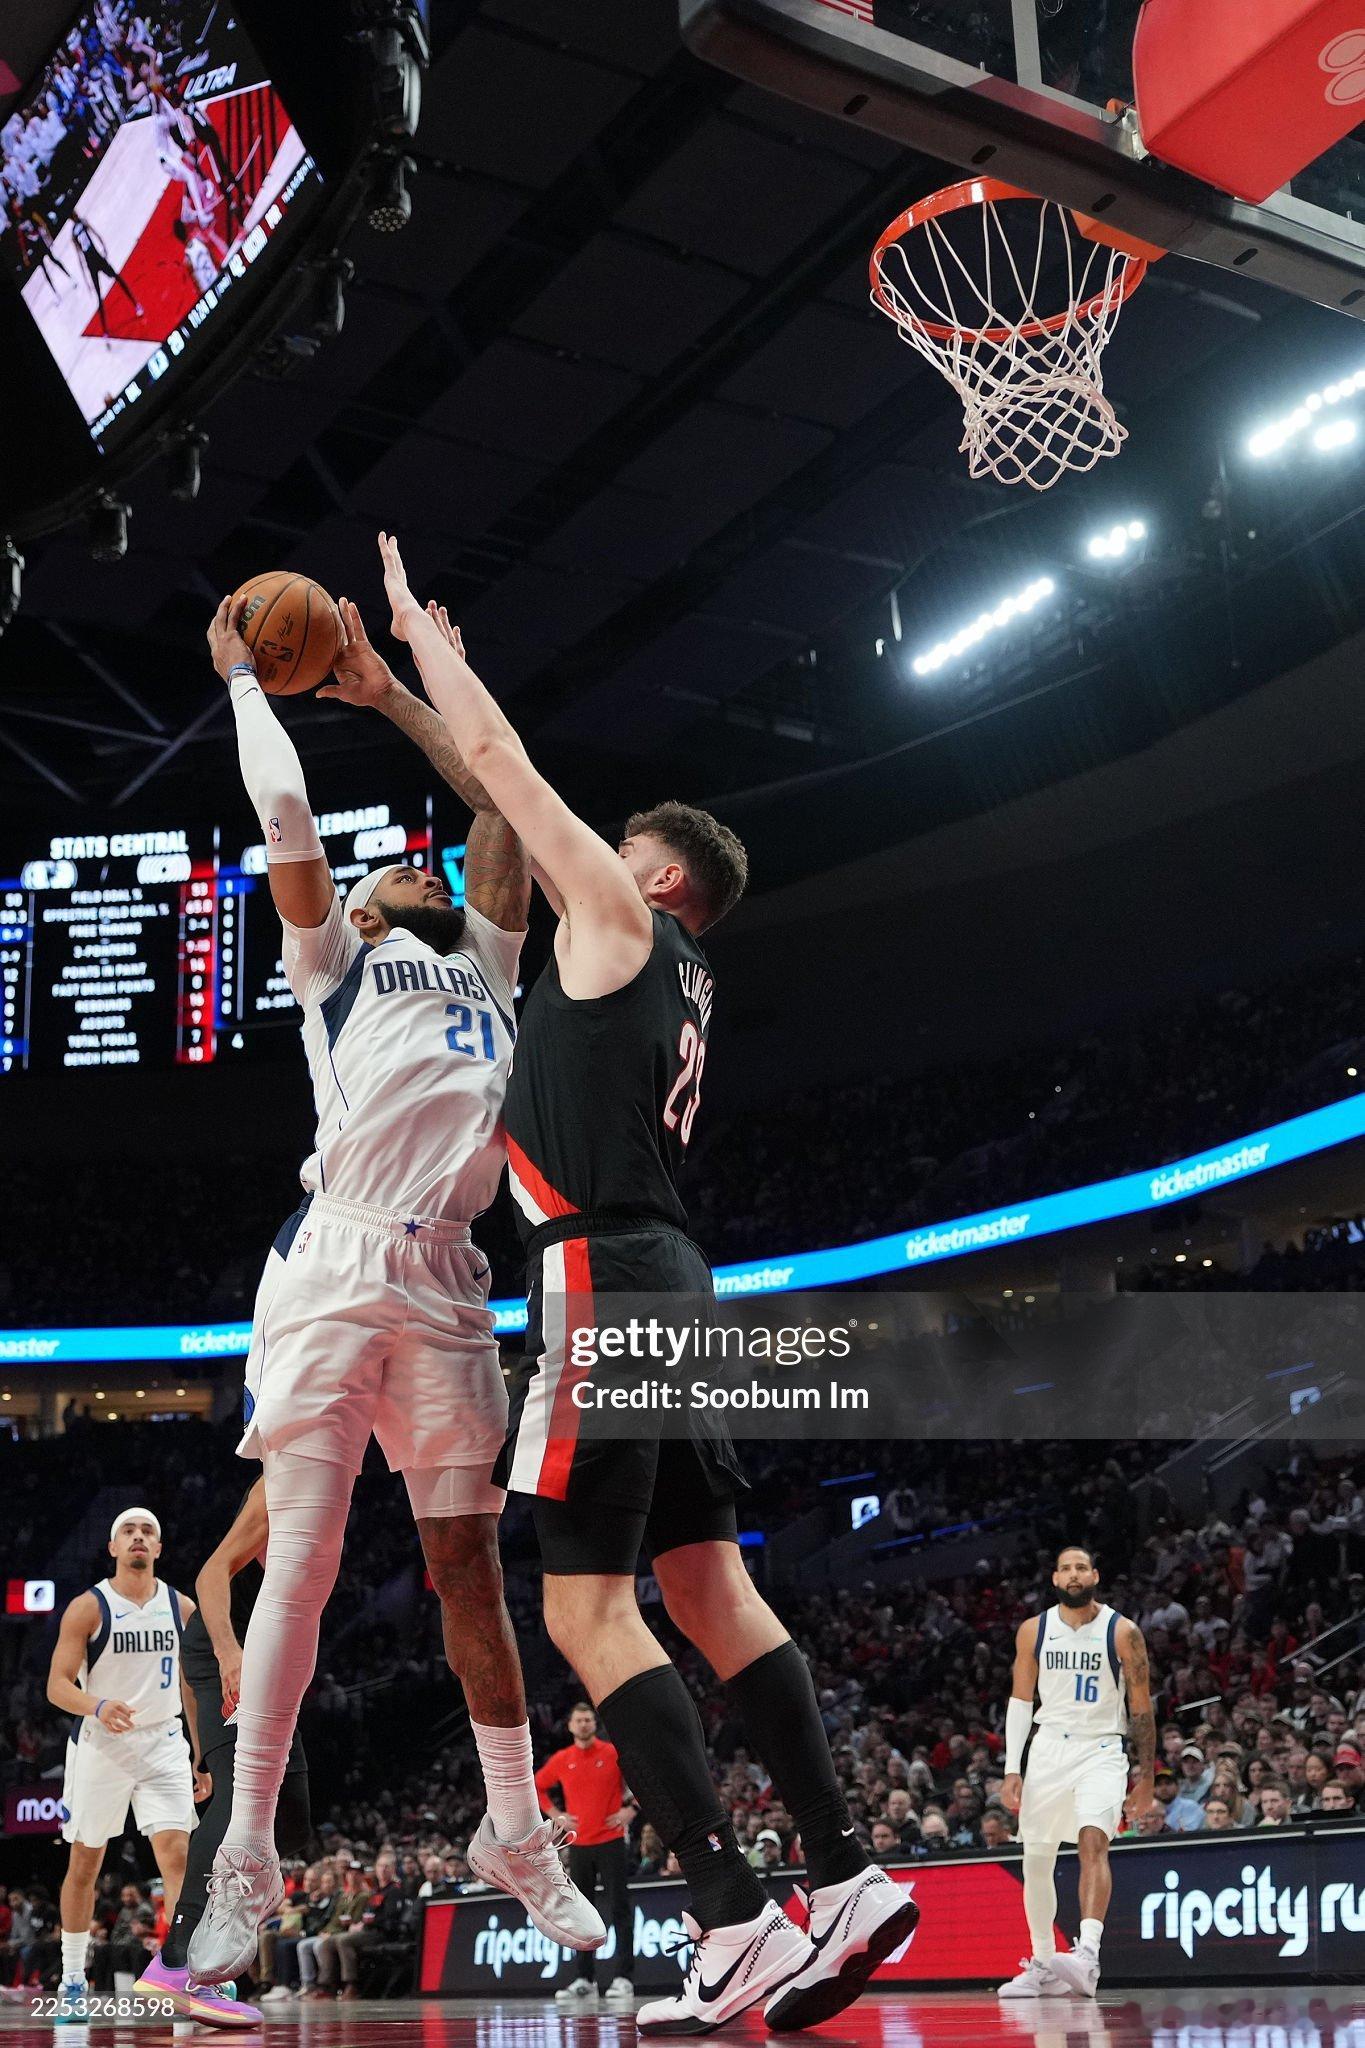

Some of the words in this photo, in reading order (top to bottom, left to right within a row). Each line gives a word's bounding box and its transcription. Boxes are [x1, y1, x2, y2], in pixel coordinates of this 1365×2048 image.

[315, 805, 390, 836] LEBOARD
[50, 836, 108, 860] STATS
[110, 830, 189, 857] CENTRAL
[371, 960, 487, 1001] DALLAS
[445, 1003, 497, 1062] 21
[1150, 1142, 1269, 1200] ticketmaster
[905, 1214, 1029, 1260] ticketmaster
[0, 1337, 60, 1357] aster
[113, 1630, 174, 1654] DALLAS
[160, 1656, 173, 1689] 9
[1046, 1651, 1102, 1671] DALLAS
[1075, 1673, 1099, 1703] 16
[1141, 1865, 1308, 1959] ripcity
